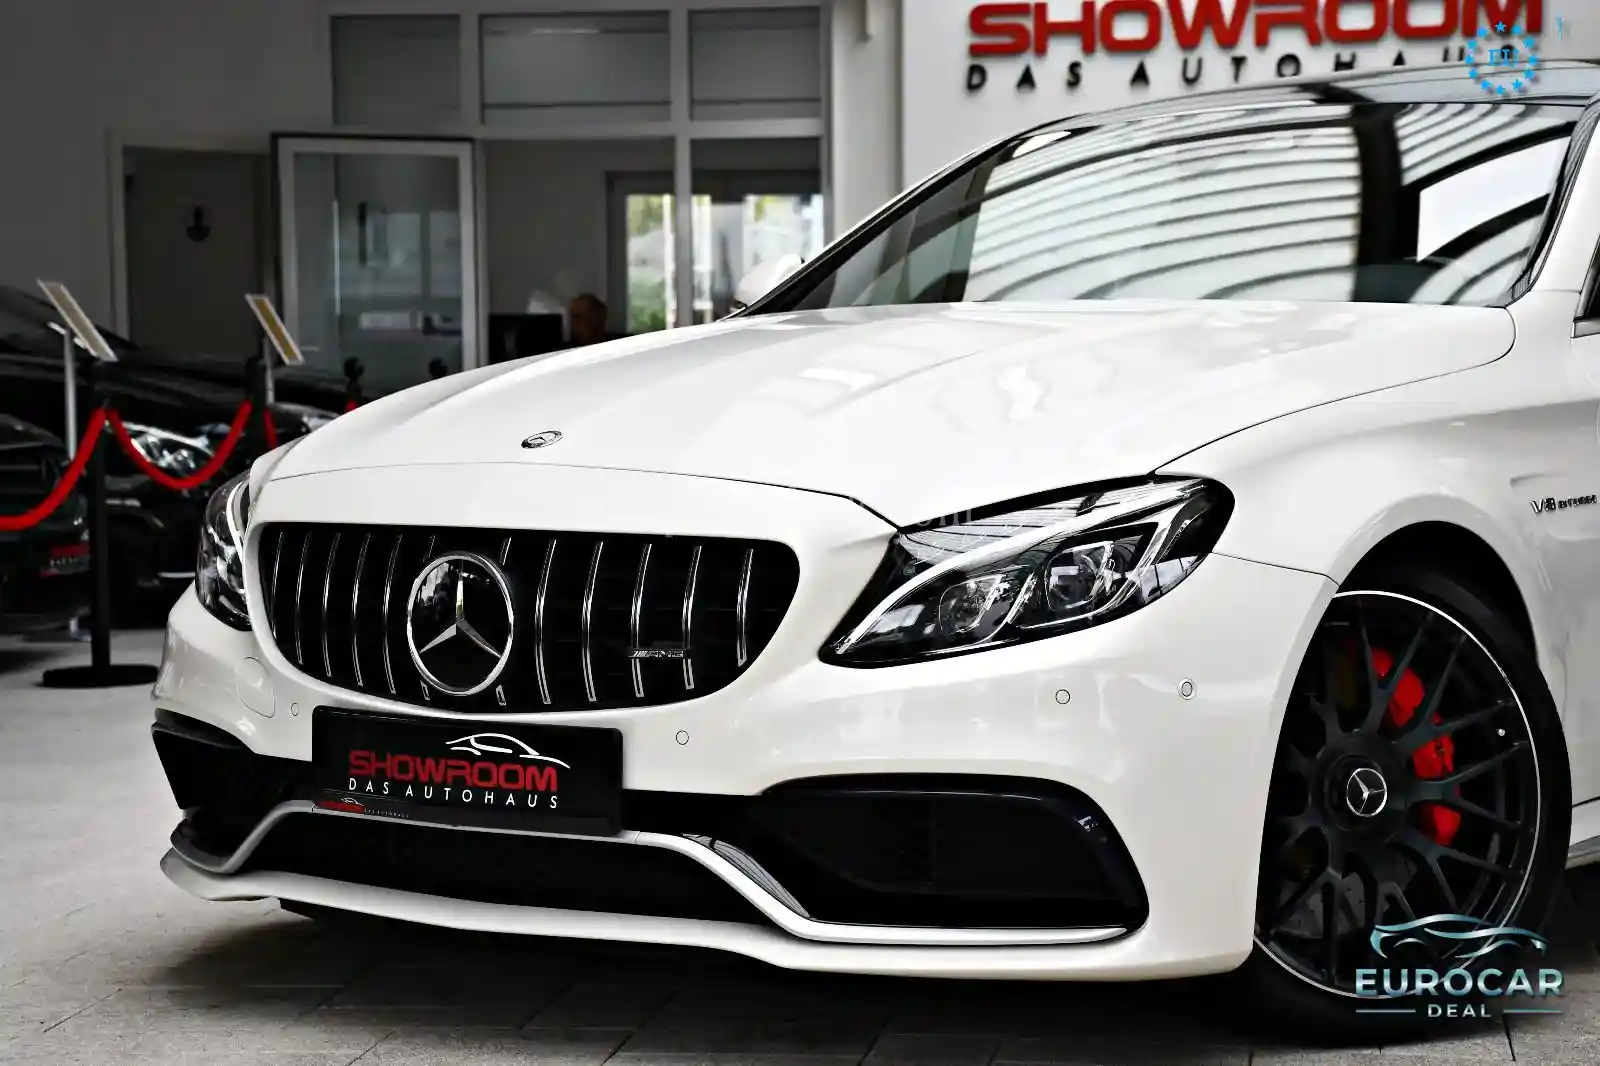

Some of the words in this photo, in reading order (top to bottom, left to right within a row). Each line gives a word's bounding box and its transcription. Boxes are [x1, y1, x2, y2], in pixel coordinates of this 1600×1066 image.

[968, 0, 1543, 57] SHOWROOM
[966, 61, 1082, 91] DAS
[1529, 496, 1556, 514] V8
[349, 750, 558, 793] SHOWROOM
[349, 777, 390, 795] DAS
[405, 784, 558, 810] AUTOHAUS
